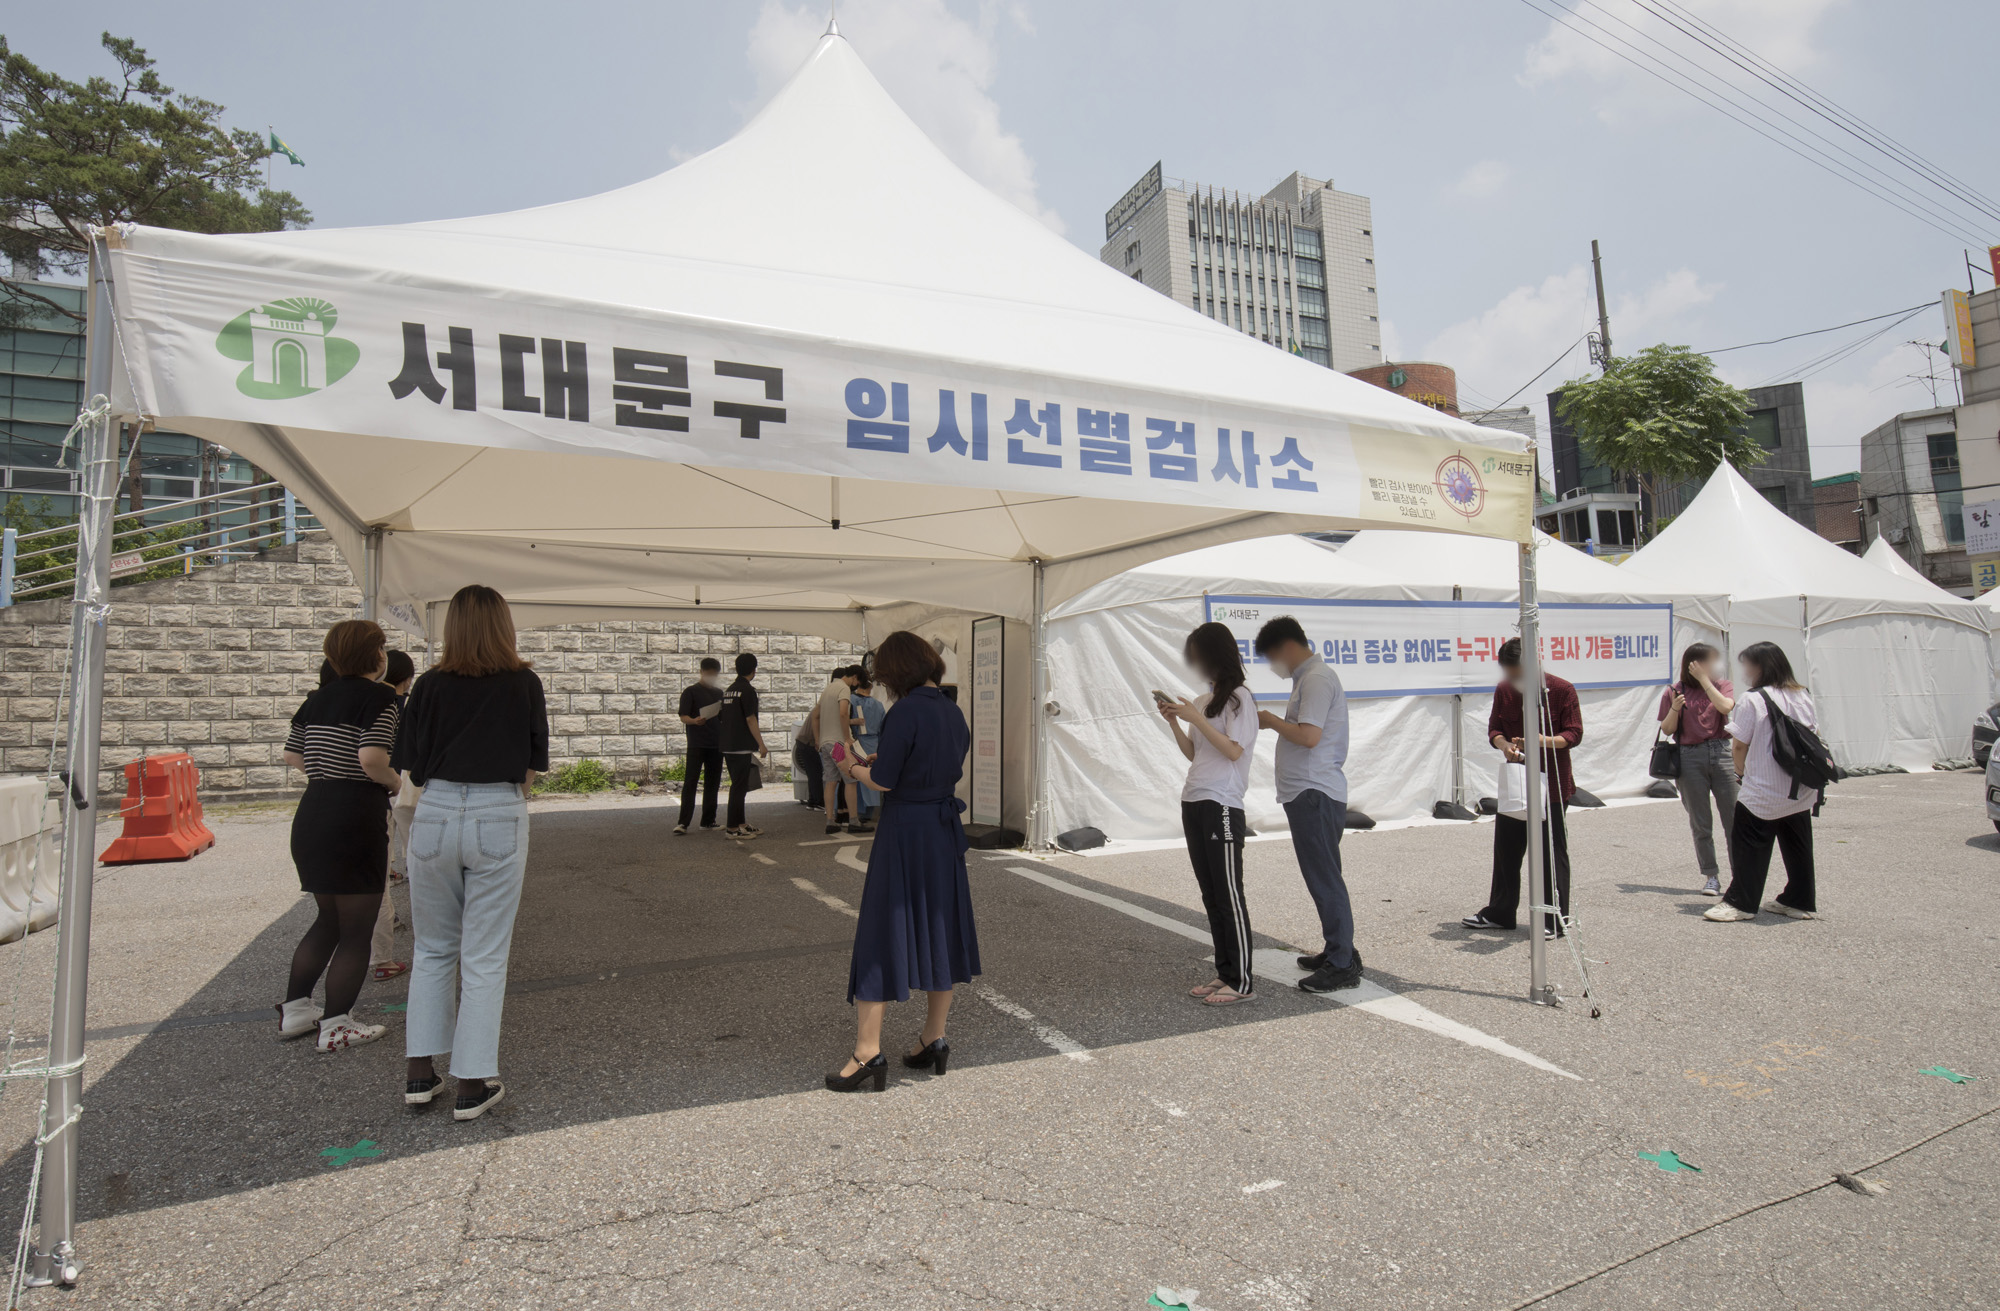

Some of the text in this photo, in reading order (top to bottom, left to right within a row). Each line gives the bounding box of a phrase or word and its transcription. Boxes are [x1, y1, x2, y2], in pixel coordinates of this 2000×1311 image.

[388, 322, 1319, 493] 서대문구 임시선별검사소
[1497, 461, 1533, 477] 서대문구
[1368, 477, 1433, 496] 빨리 검사 받아야
[1371, 490, 1428, 507] 빨리 끝장낼 수
[1399, 506, 1437, 520] 있습니다!
[1229, 609, 1260, 620] 서대문구
[1323, 639, 1358, 665] 의심
[1363, 639, 1398, 664] 증상
[1403, 638, 1452, 664] 없어도
[1550, 636, 1580, 661] 검사
[1585, 635, 1659, 660] 가능합니다!
[1222, 816, 1234, 841] sportif
